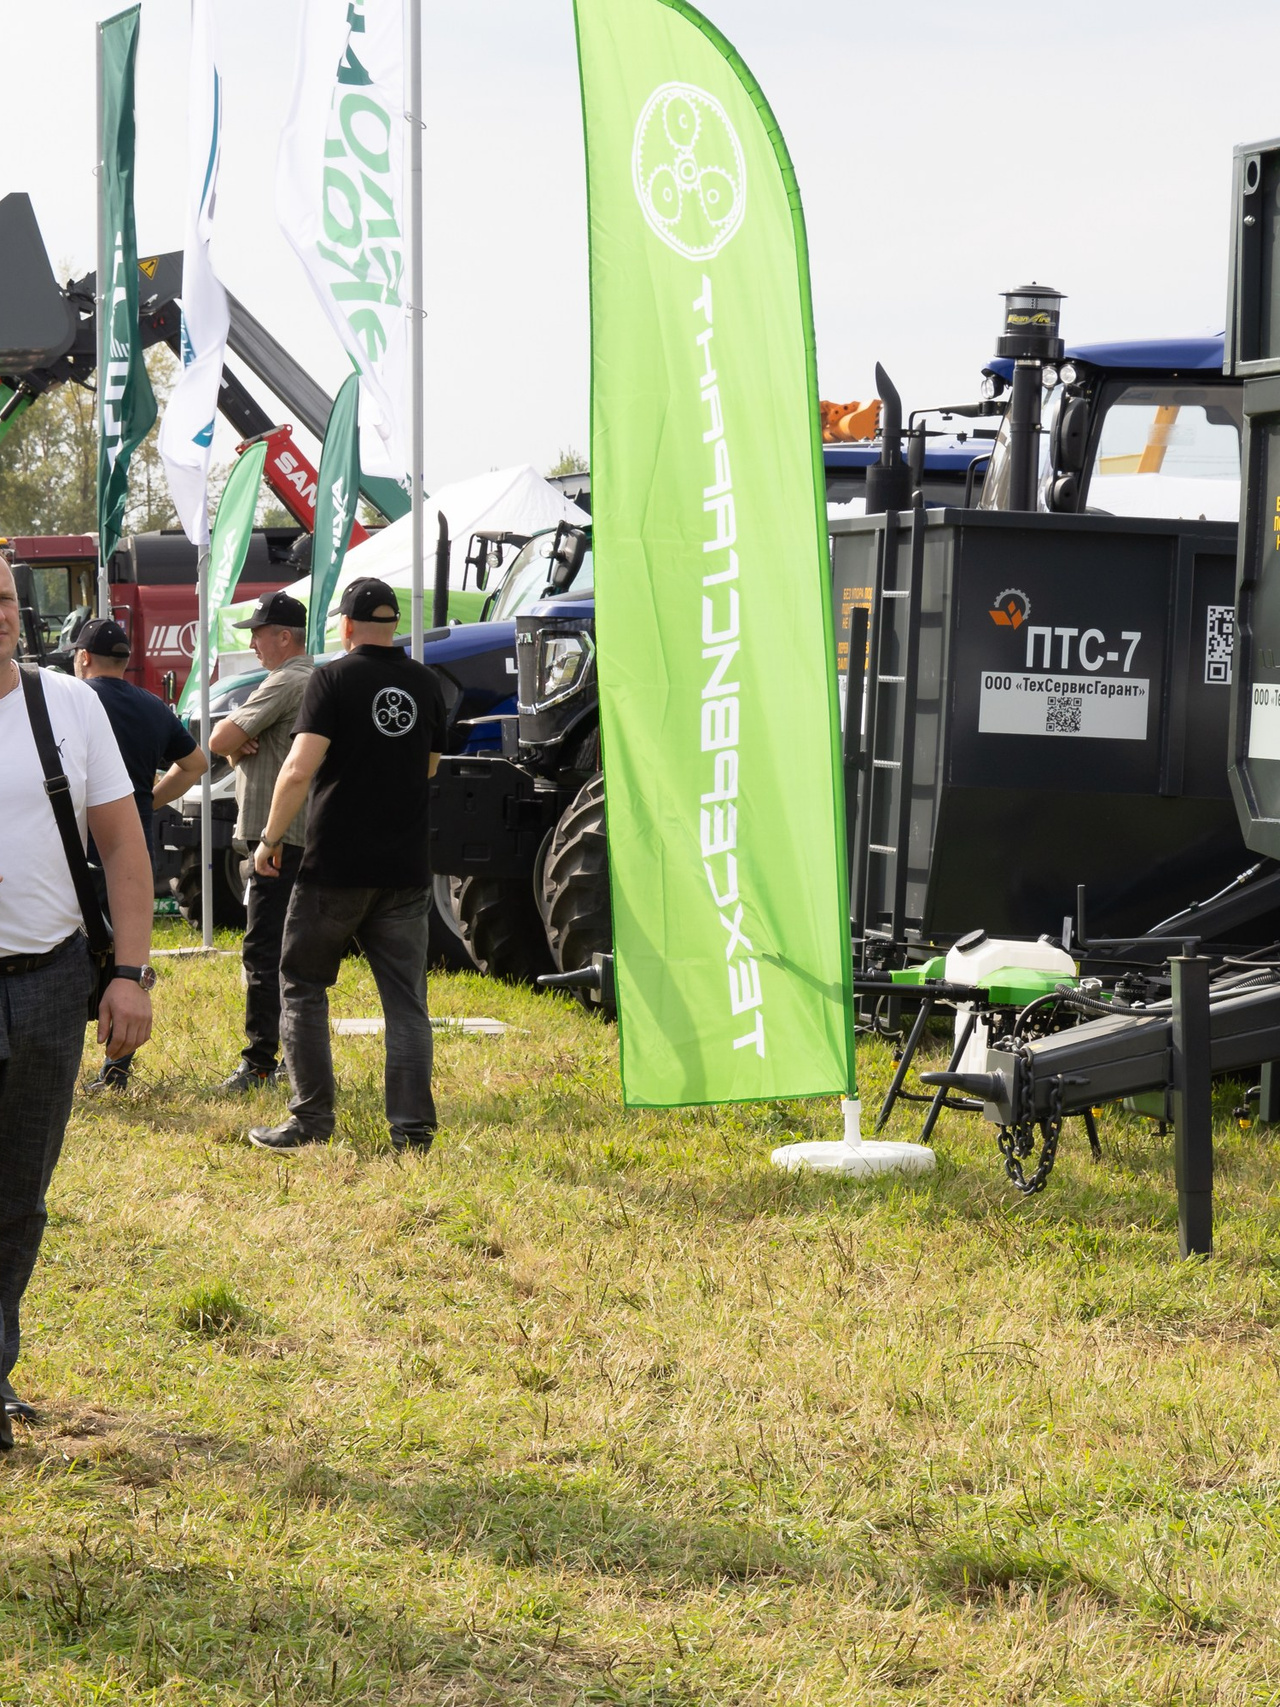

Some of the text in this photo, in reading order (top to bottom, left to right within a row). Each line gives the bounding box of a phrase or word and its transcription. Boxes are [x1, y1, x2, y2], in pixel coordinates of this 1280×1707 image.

[273, 451, 318, 508] SAN
[1026, 626, 1141, 673] ПТС-7
[985, 675, 1146, 698] ООО «ТехСервисГарант»
